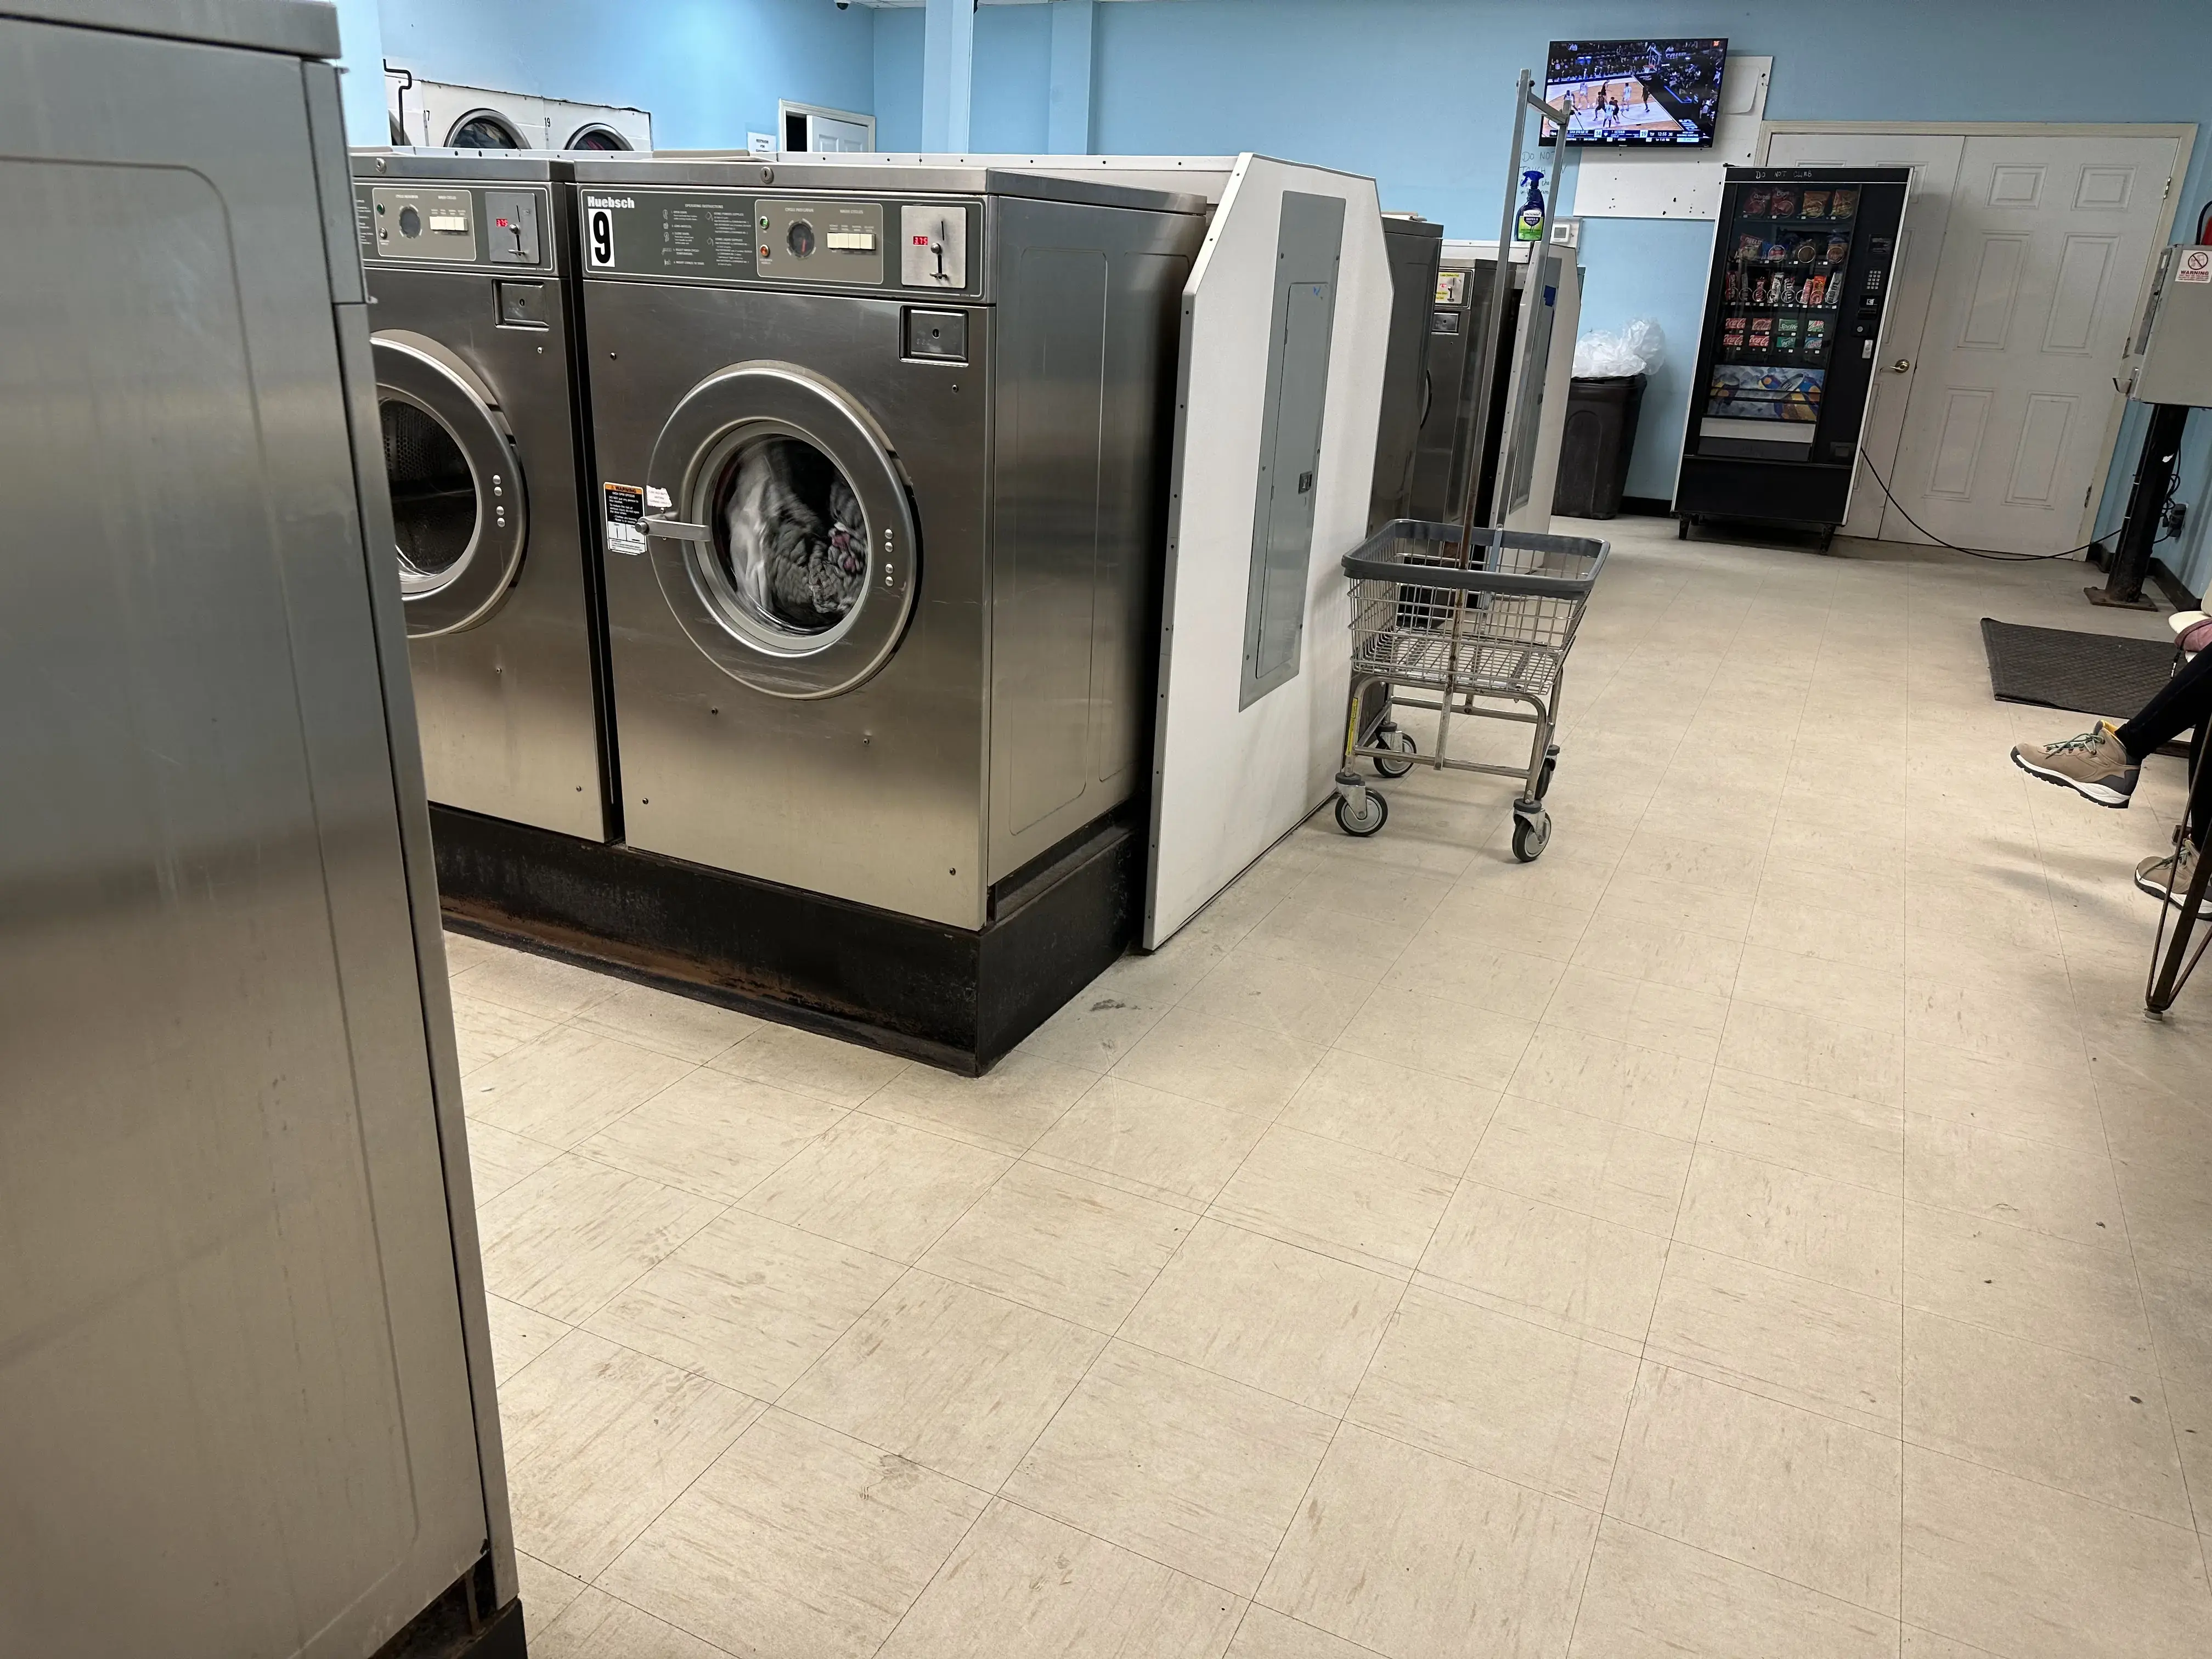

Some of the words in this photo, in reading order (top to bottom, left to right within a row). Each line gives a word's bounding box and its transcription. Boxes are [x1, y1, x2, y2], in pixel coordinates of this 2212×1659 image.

[544, 117, 551, 127] 19
[587, 196, 635, 208] Huebsch
[593, 211, 611, 264] 9
